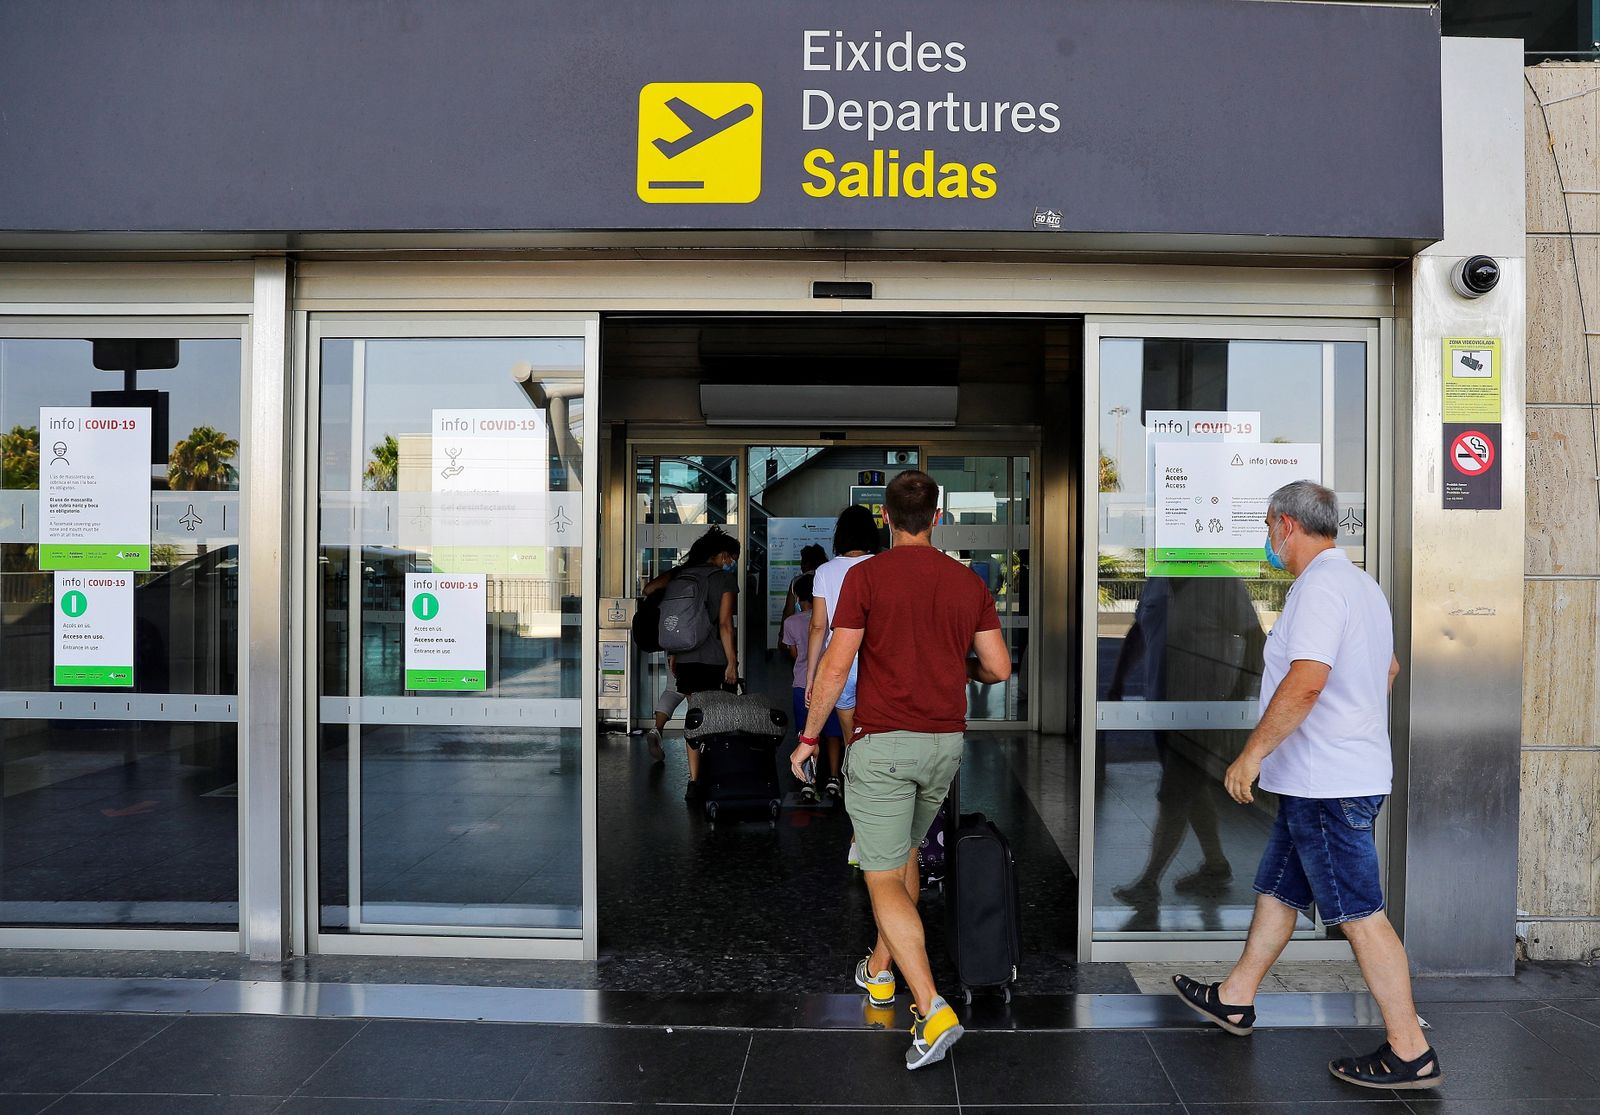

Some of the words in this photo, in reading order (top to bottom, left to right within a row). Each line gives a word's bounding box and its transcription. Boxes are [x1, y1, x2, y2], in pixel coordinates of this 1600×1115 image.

[803, 30, 968, 73] Eixides
[802, 89, 1061, 141] Departures
[801, 148, 998, 199] Salidas
[1035, 214, 1046, 223] GO
[49, 417, 75, 430] info
[85, 419, 136, 430] COVID-19
[441, 417, 469, 432] info
[479, 419, 536, 431] COVID-19
[1153, 419, 1183, 434] info
[1194, 421, 1253, 434] COVID-19
[1249, 457, 1264, 465] info
[1269, 457, 1298, 465] COVID-19
[62, 577, 81, 587] info
[88, 579, 126, 587] COVID-19
[413, 579, 433, 590] info
[440, 581, 479, 590] COVID-19
